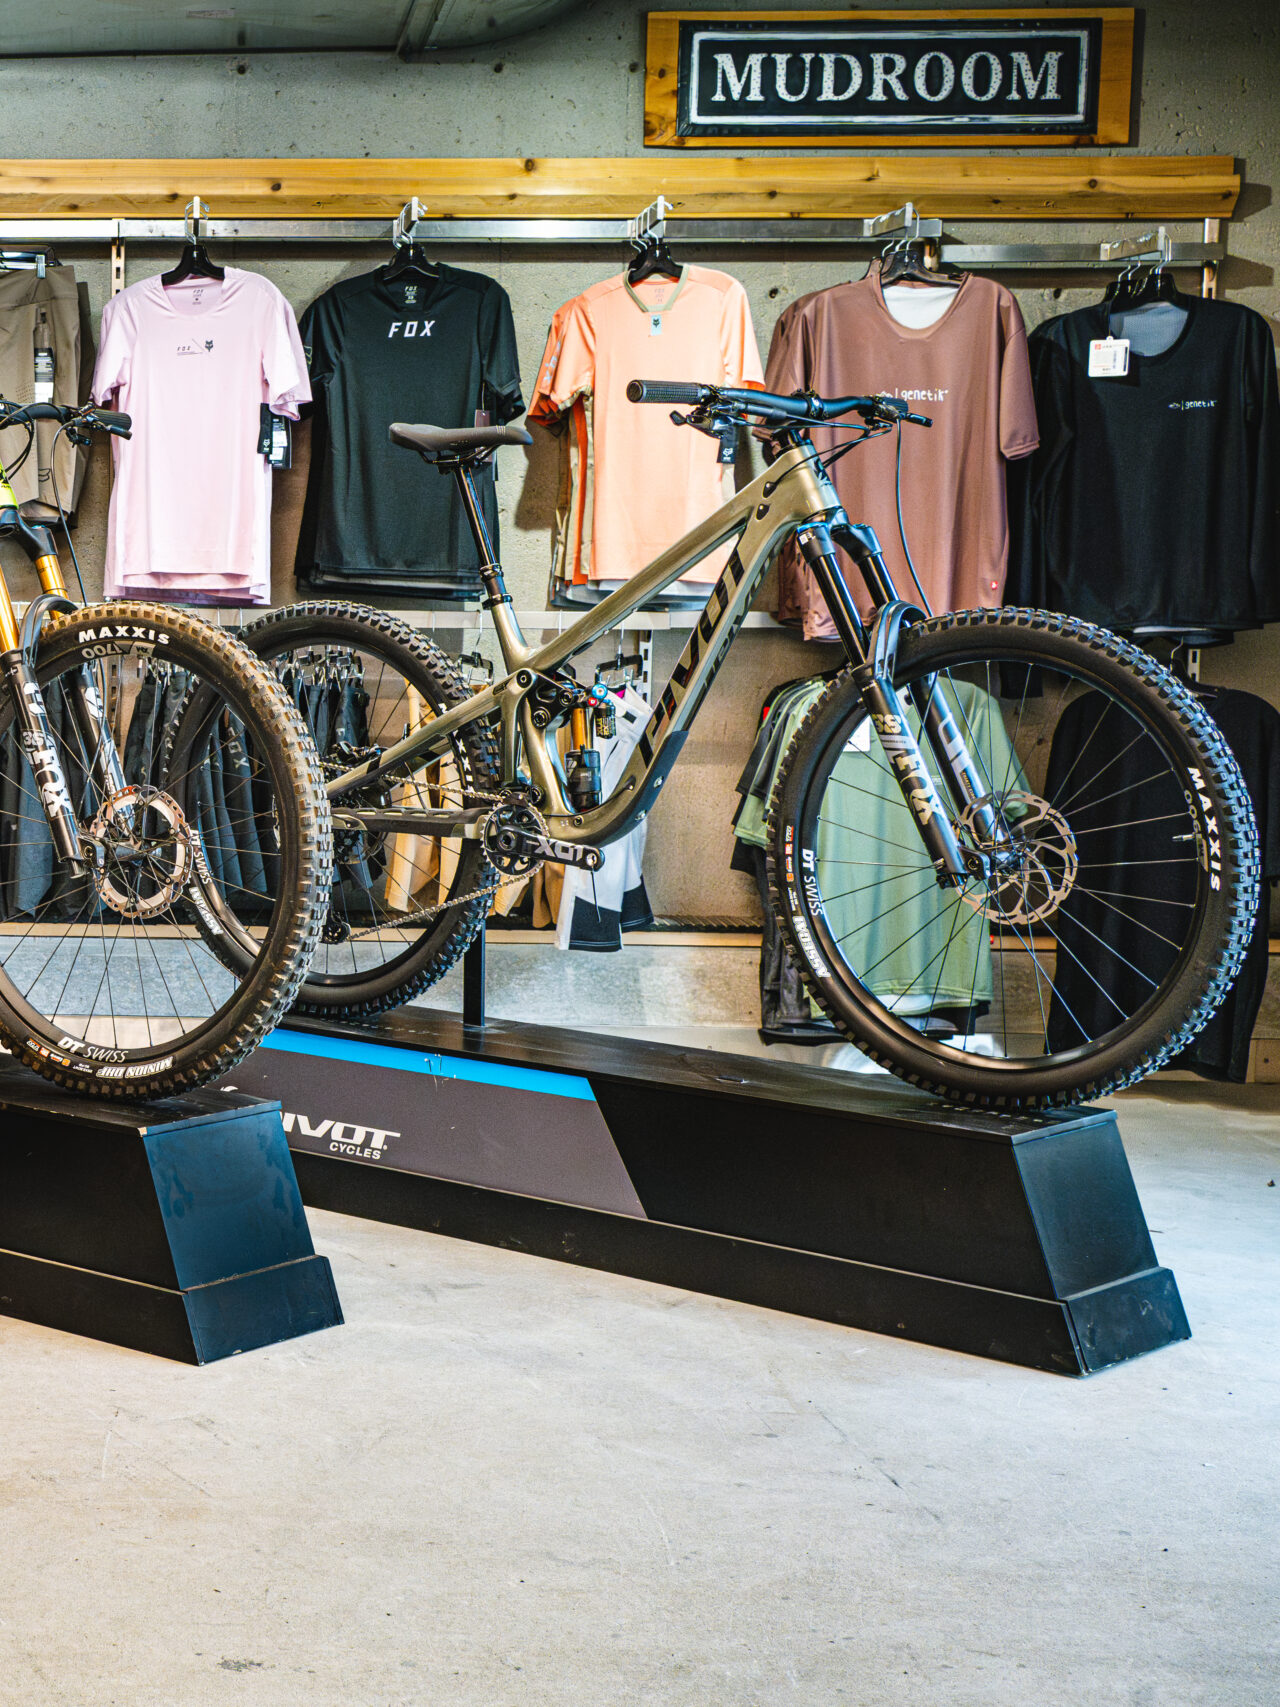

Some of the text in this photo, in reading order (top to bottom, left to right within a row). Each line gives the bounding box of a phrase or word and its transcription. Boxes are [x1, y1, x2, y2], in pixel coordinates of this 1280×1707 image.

[711, 50, 1064, 103] MUDROOM
[388, 320, 436, 338] FOX
[901, 388, 948, 401] genetik
[78, 625, 170, 645] MAXXIS
[33, 749, 74, 818] FOX
[895, 752, 944, 826] FOX
[1187, 767, 1221, 891] MAXXIS
[193, 850, 213, 885] SWISS
[802, 848, 824, 916] DT SWISS
[792, 915, 832, 978] ASSEGAI
[56, 1036, 86, 1053] DT
[82, 1046, 129, 1063] SWISS
[124, 1056, 174, 1079] MINION
[279, 1110, 402, 1150] IVOT
[329, 1141, 382, 1160] CYCLES
